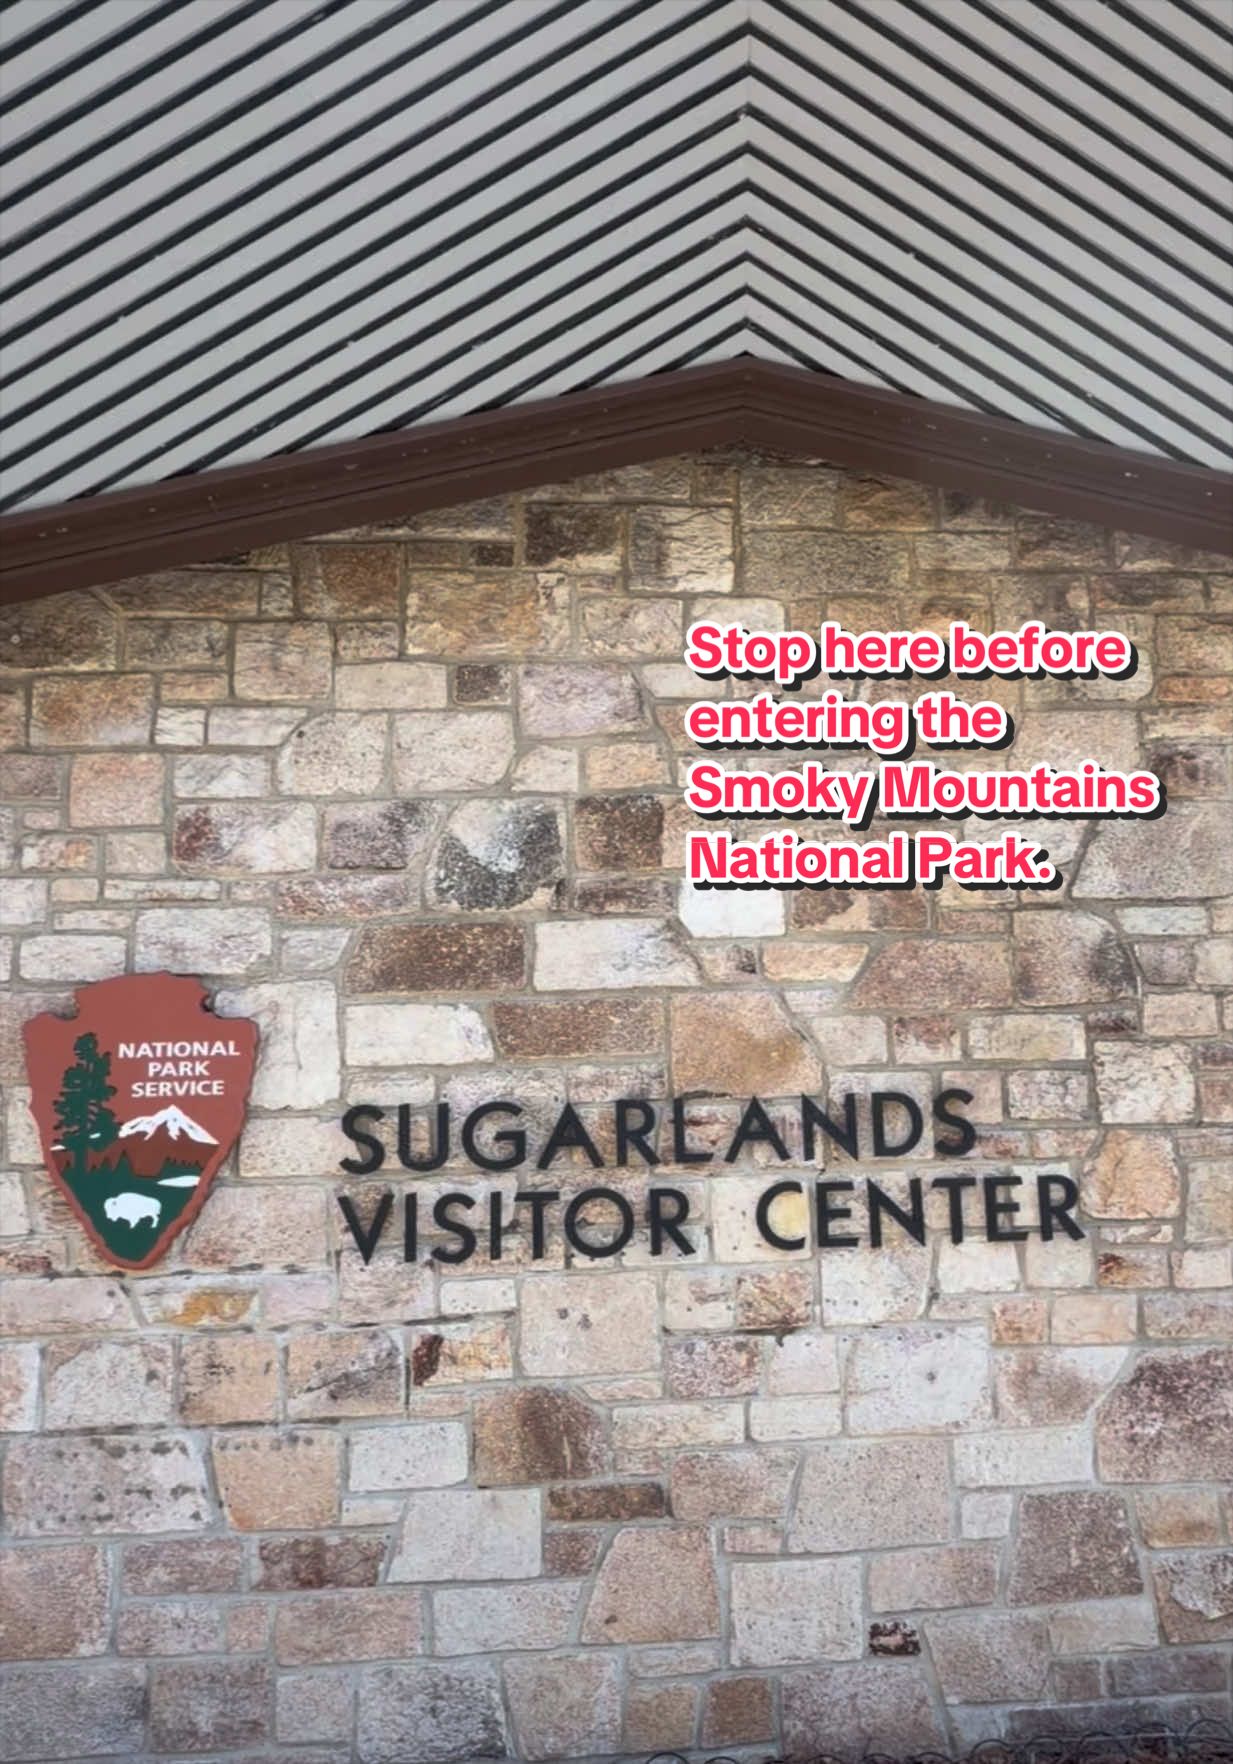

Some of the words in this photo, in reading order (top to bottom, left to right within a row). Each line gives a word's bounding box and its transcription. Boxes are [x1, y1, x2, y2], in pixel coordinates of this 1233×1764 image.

[117, 1040, 241, 1059] NATIONAL
[147, 1060, 211, 1078] PARK
[130, 1079, 226, 1099] SERVICE
[338, 1088, 978, 1175] SUGARLANDS
[336, 1187, 697, 1266] VISITOR
[755, 1173, 1086, 1252] CENTER
